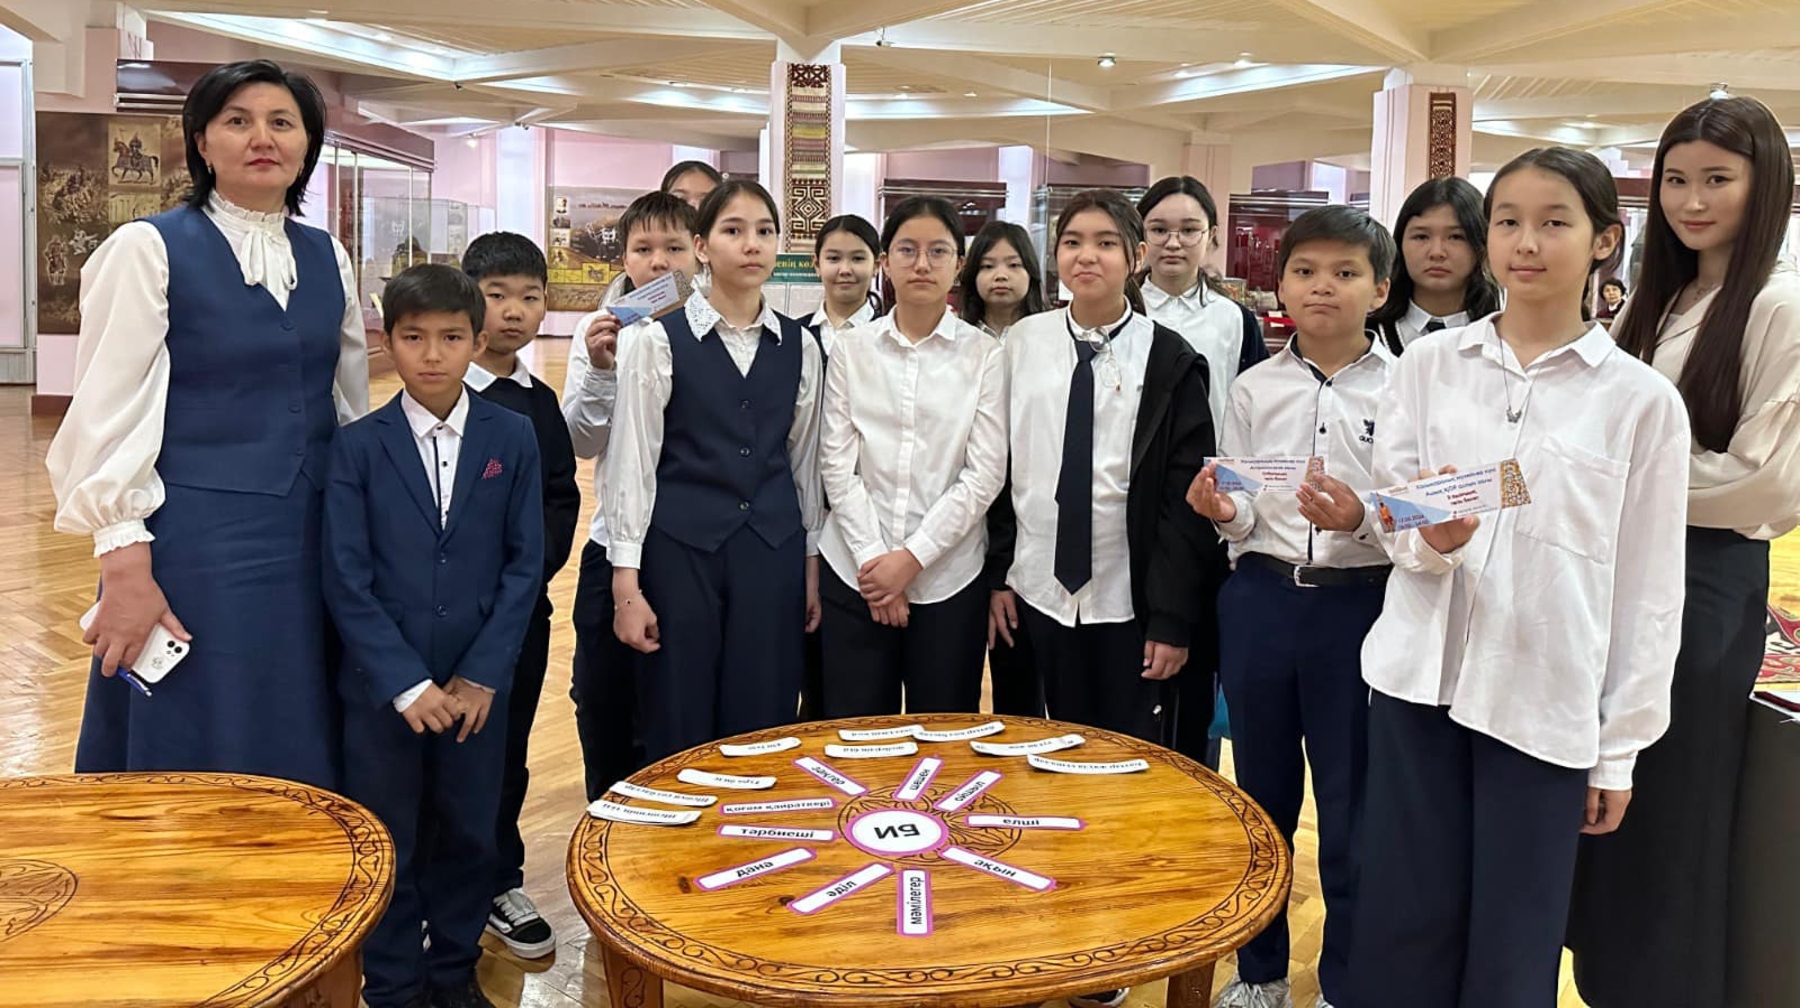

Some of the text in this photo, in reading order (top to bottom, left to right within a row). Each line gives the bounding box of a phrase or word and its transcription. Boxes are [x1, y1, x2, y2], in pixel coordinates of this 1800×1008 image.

[1003, 817, 1039, 827] елші
[874, 823, 920, 840] БИ
[736, 860, 774, 878] дана
[828, 880, 857, 898] әділ
[906, 876, 925, 925] мәмілегер
